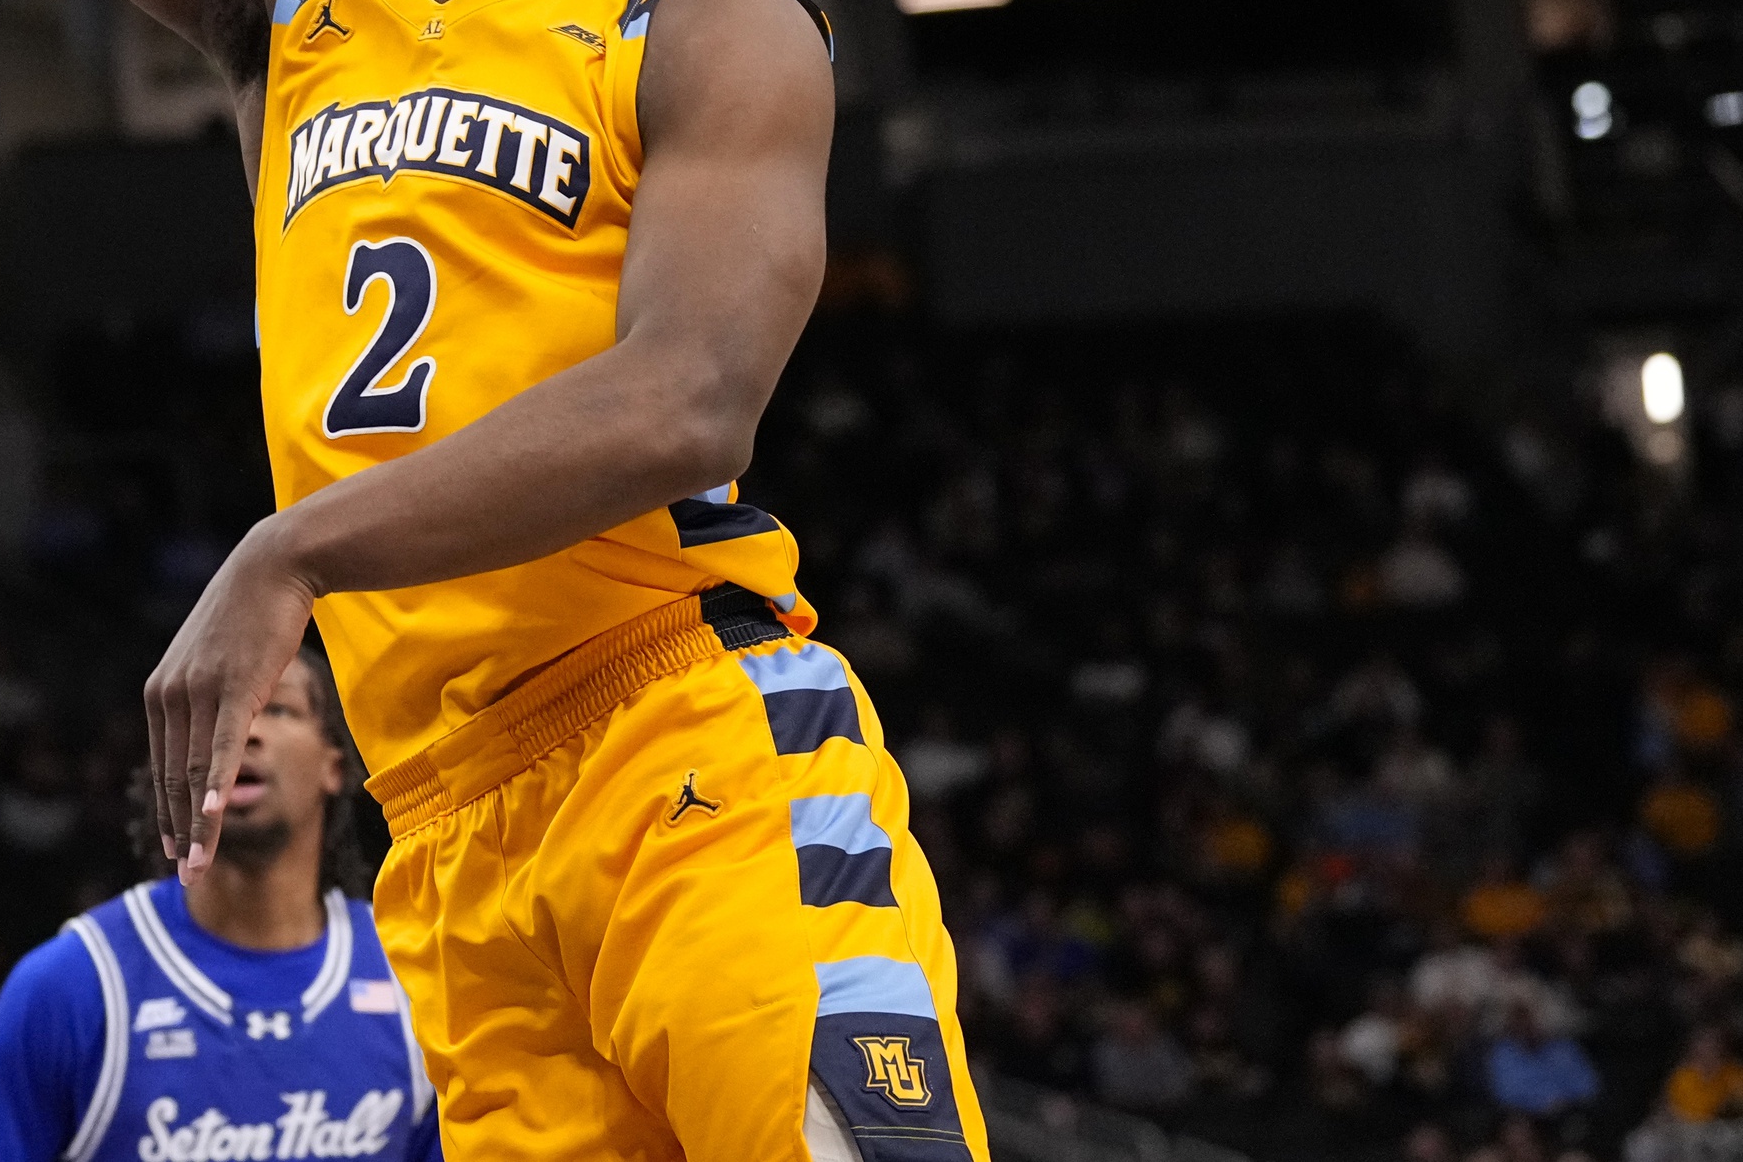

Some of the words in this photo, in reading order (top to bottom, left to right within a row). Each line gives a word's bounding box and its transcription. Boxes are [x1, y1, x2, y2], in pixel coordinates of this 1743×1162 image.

[286, 95, 582, 218] MARQUETTE
[322, 236, 437, 440] 2
[856, 1038, 929, 1104] MU
[138, 1096, 275, 1162] Seton
[275, 1089, 404, 1160] Hall
